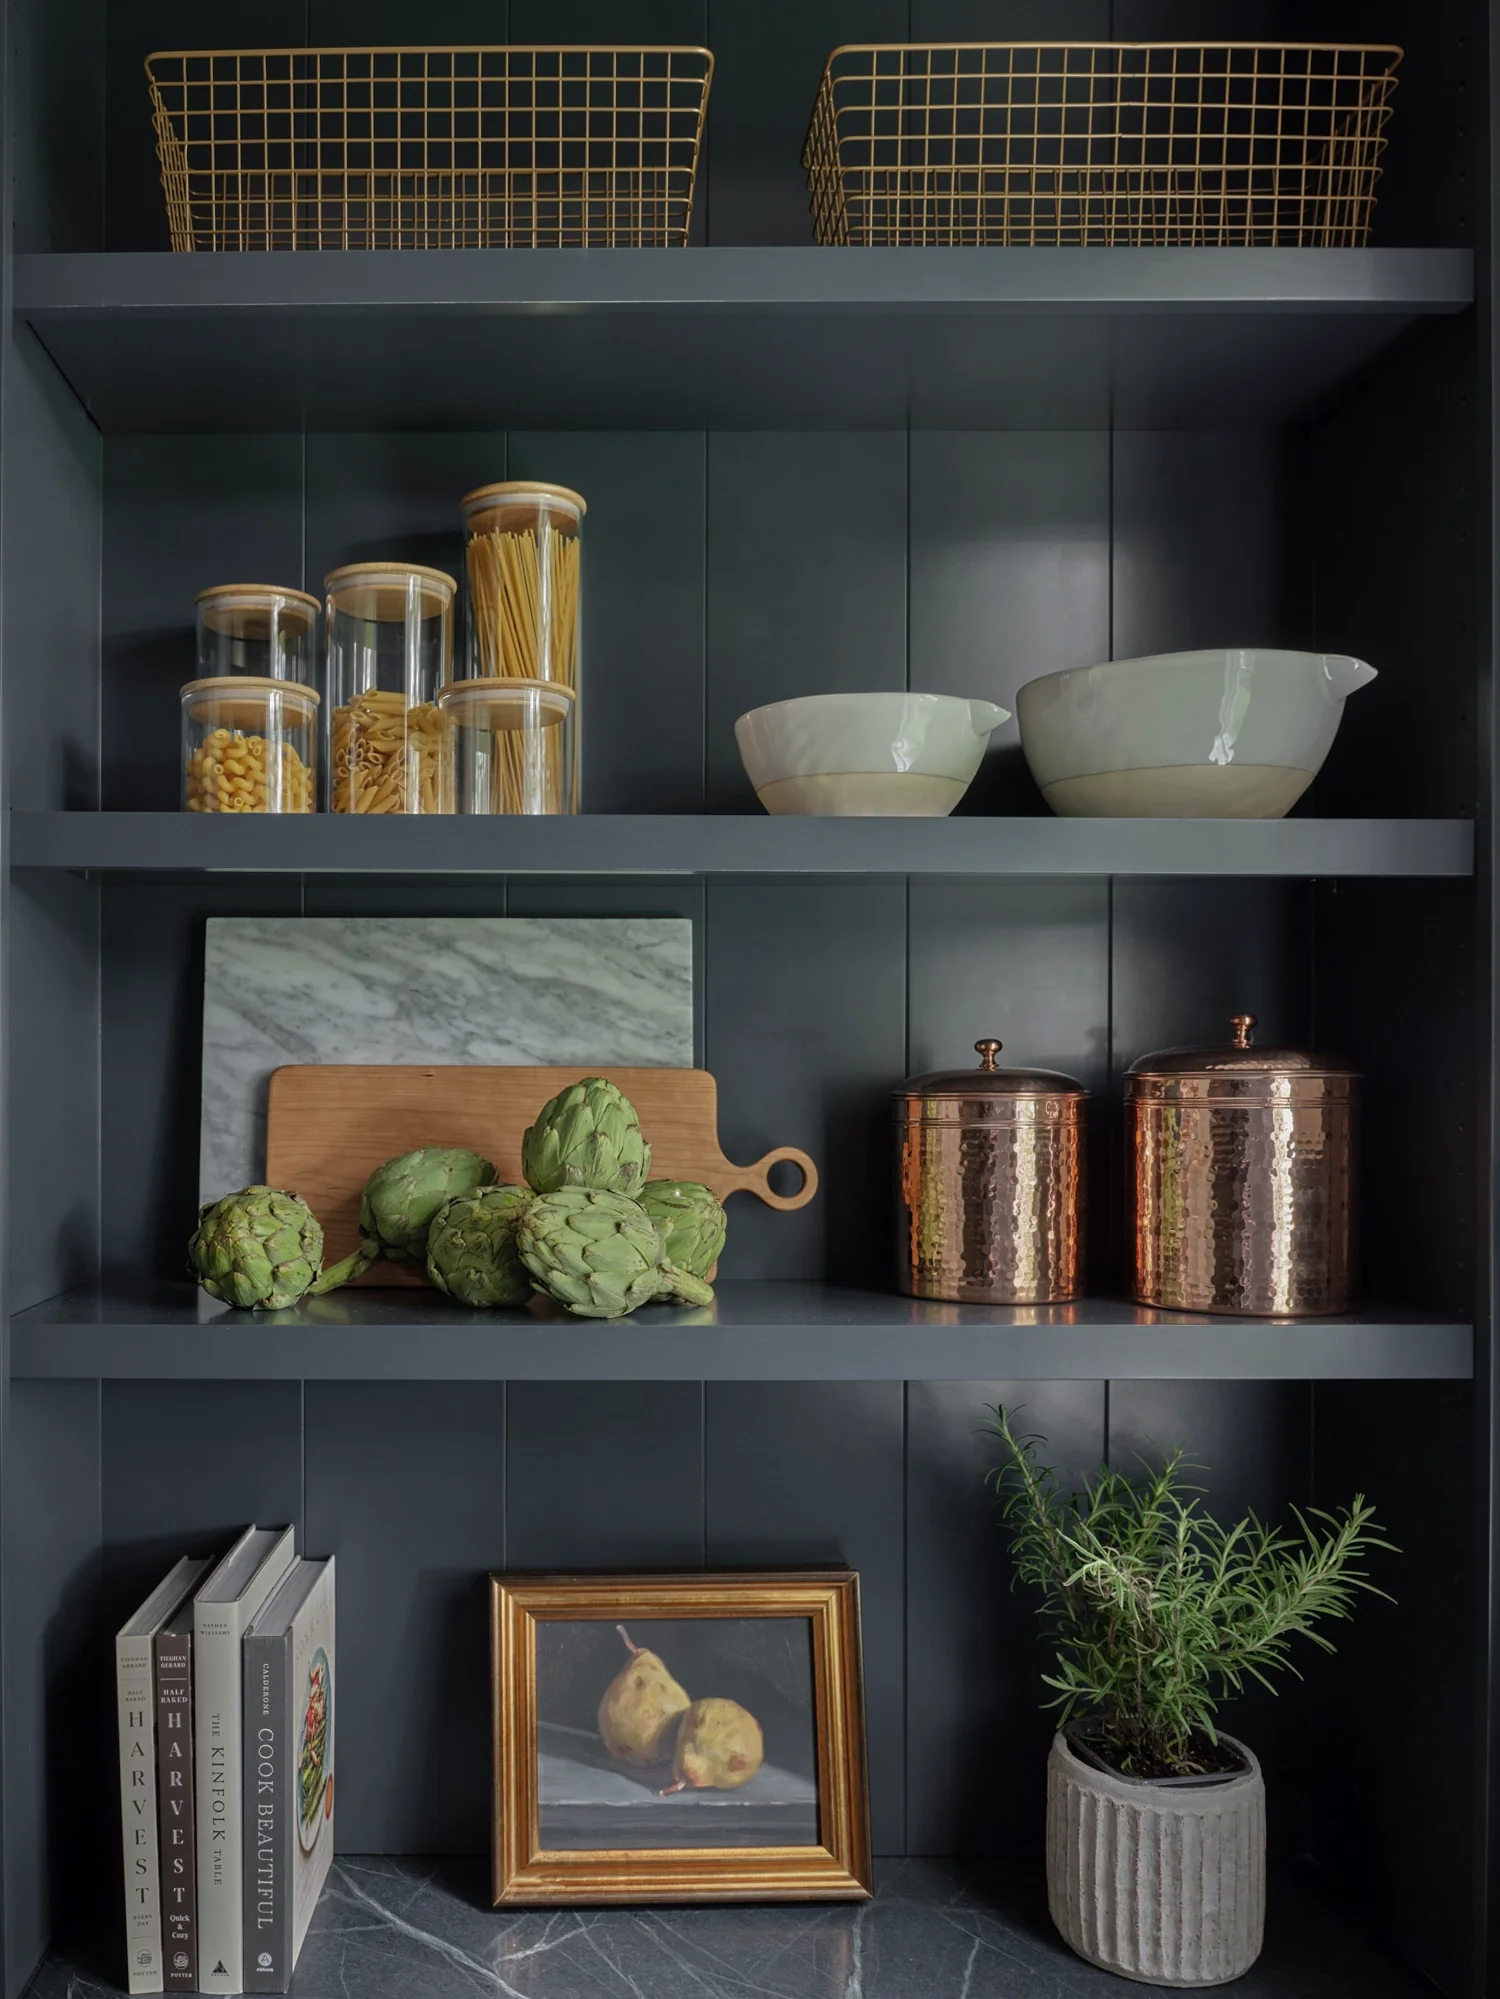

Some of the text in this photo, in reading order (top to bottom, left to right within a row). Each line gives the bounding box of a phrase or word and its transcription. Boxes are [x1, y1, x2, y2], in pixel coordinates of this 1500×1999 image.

[161, 1696, 188, 1704] BAKED
[262, 1663, 270, 1716] CALDERONE
[129, 1711, 149, 1904] HARVEST
[168, 1713, 185, 1902] HARVEST
[211, 1713, 226, 1885] THE KINFOLK TABLE
[257, 1728, 274, 1929] COOK BEAUTIFUL
[169, 1914, 190, 1922] Quick
[171, 1931, 189, 1940] Cozy
